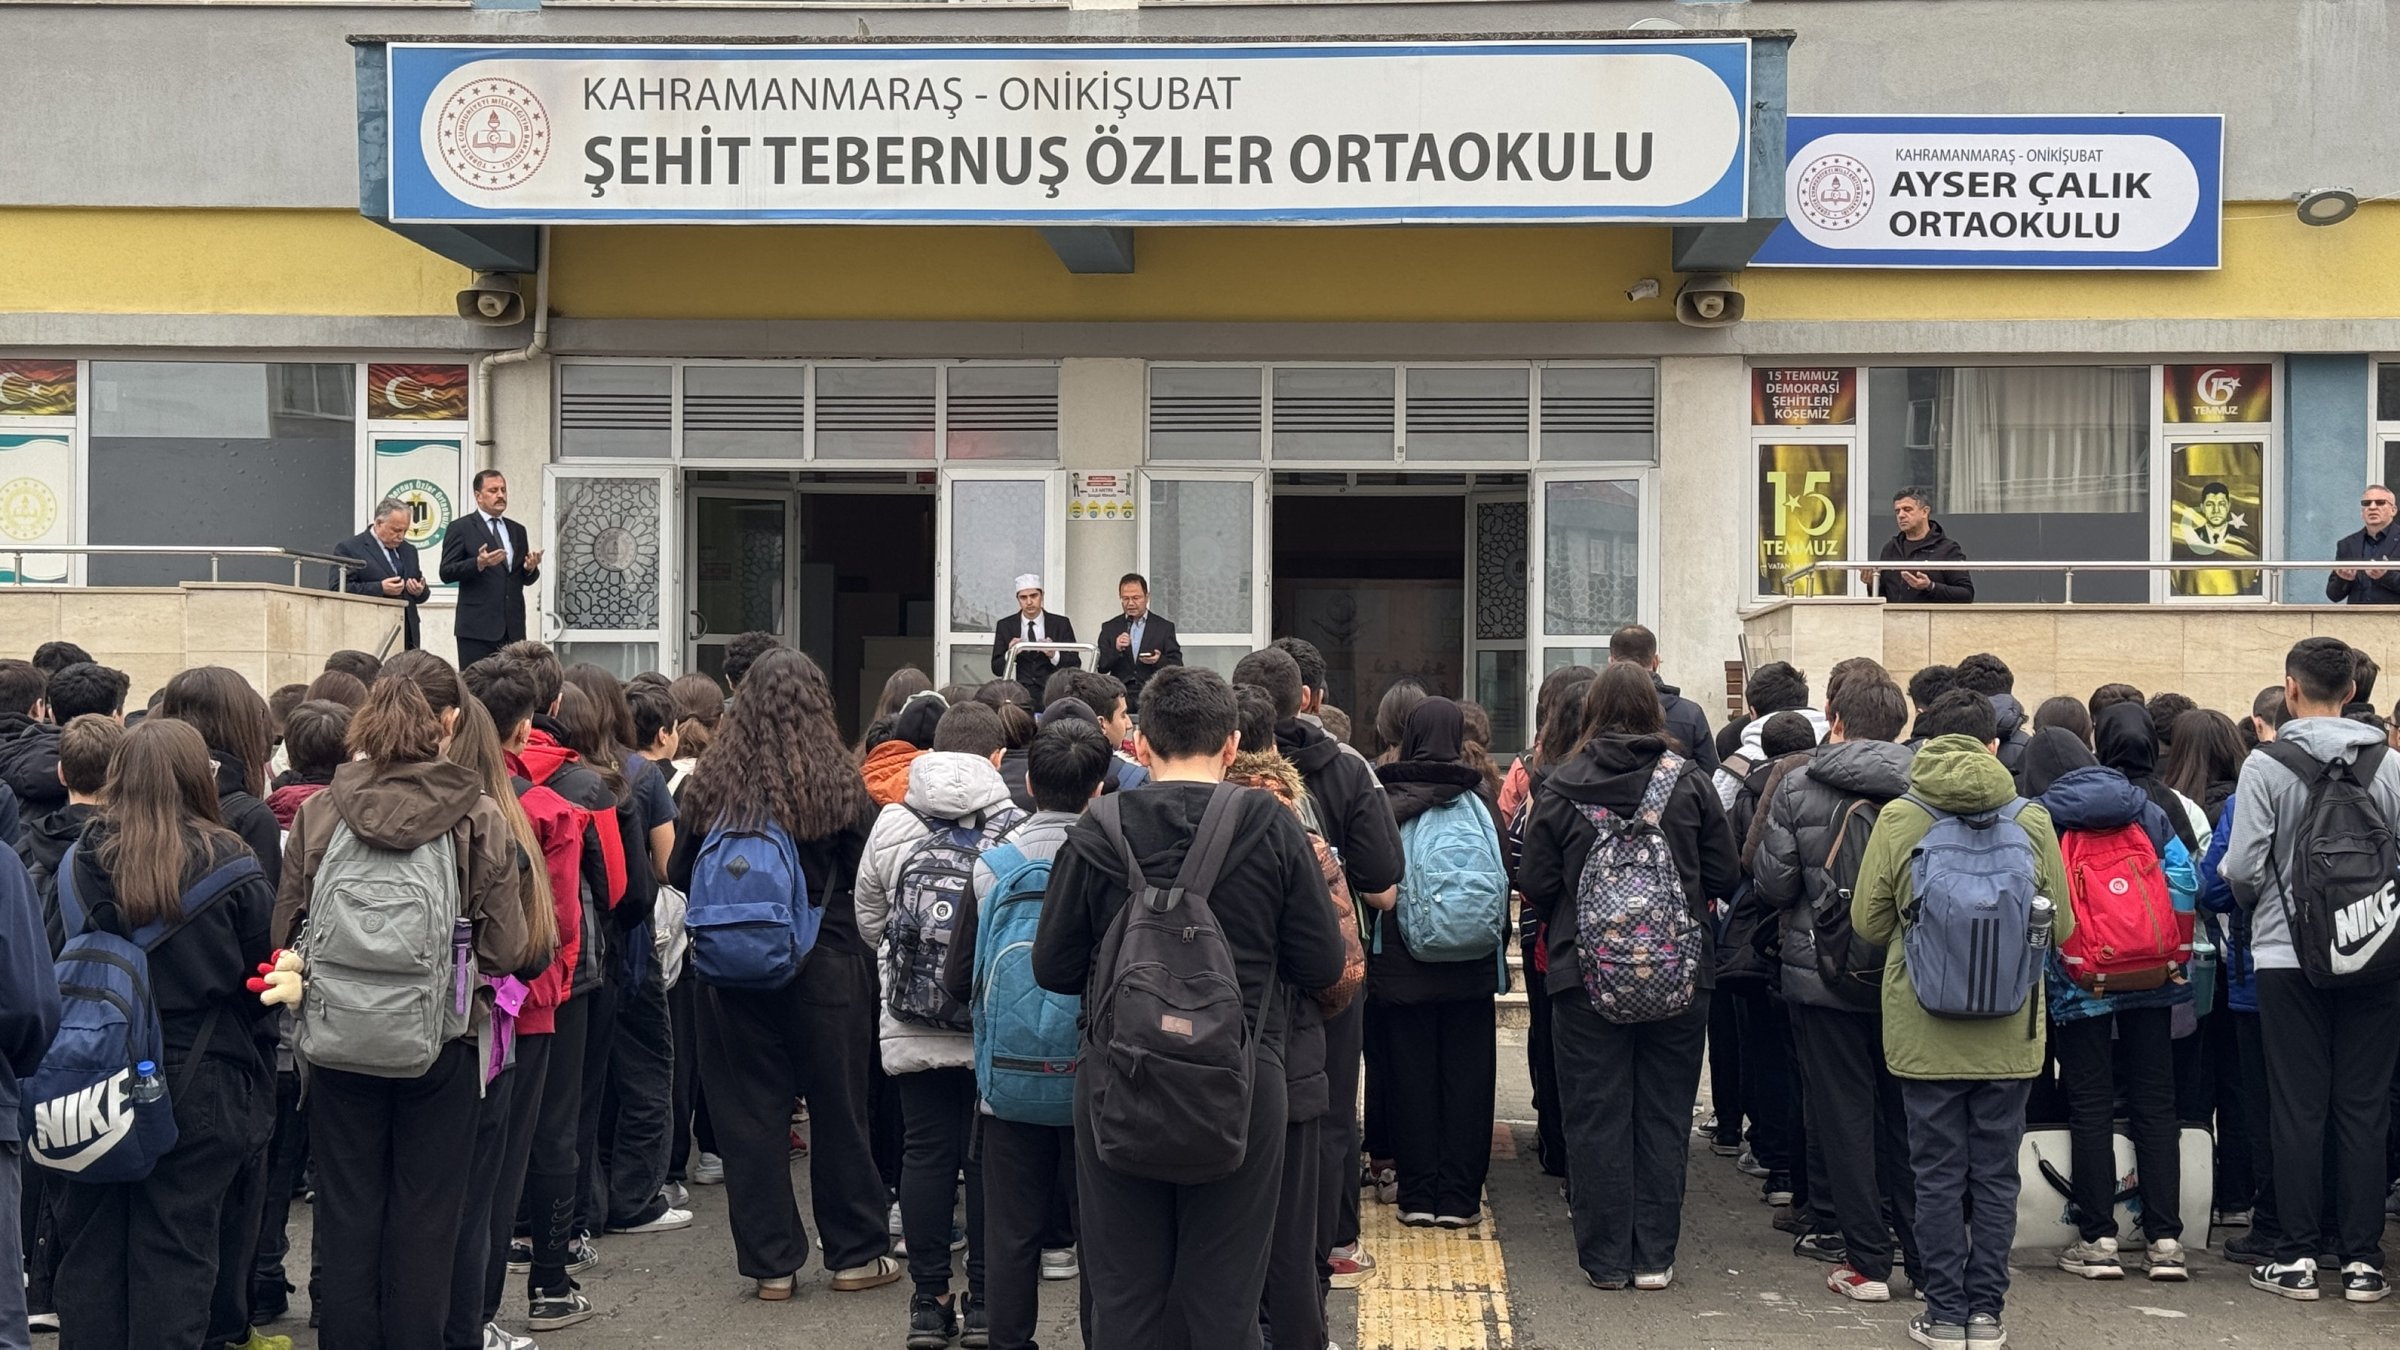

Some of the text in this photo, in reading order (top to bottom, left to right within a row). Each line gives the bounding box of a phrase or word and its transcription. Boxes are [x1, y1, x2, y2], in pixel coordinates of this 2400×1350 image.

[585, 77, 963, 119] KAHRAMANMARAŞ
[999, 70, 1241, 119] ONİKİŞUBAT
[585, 124, 1653, 199] ŞEHİT TEBERNUŞ ÖZLER ORTAOKULU
[1896, 148, 2016, 165] KAHRAMANMARAŞ
[2027, 148, 2104, 165] ONİKİŞUBAT
[1889, 171, 2017, 198] AYSER
[2029, 171, 2152, 206] ÇALIK
[1889, 210, 2120, 239] ORTAOKULU
[1767, 371, 1839, 381] 15 TEMMUZ
[1766, 382, 1840, 394] DEMOKRASİ
[1772, 394, 1833, 409] ŞEHİTLERİ
[2193, 406, 2239, 415] TEMMUZ
[1774, 406, 1831, 421] KÖŞEMİZ
[1766, 471, 1836, 536] 15
[1763, 540, 1839, 556] TEMMUZ
[2334, 879, 2397, 949] NIKE
[34, 1067, 132, 1150] NIKE
